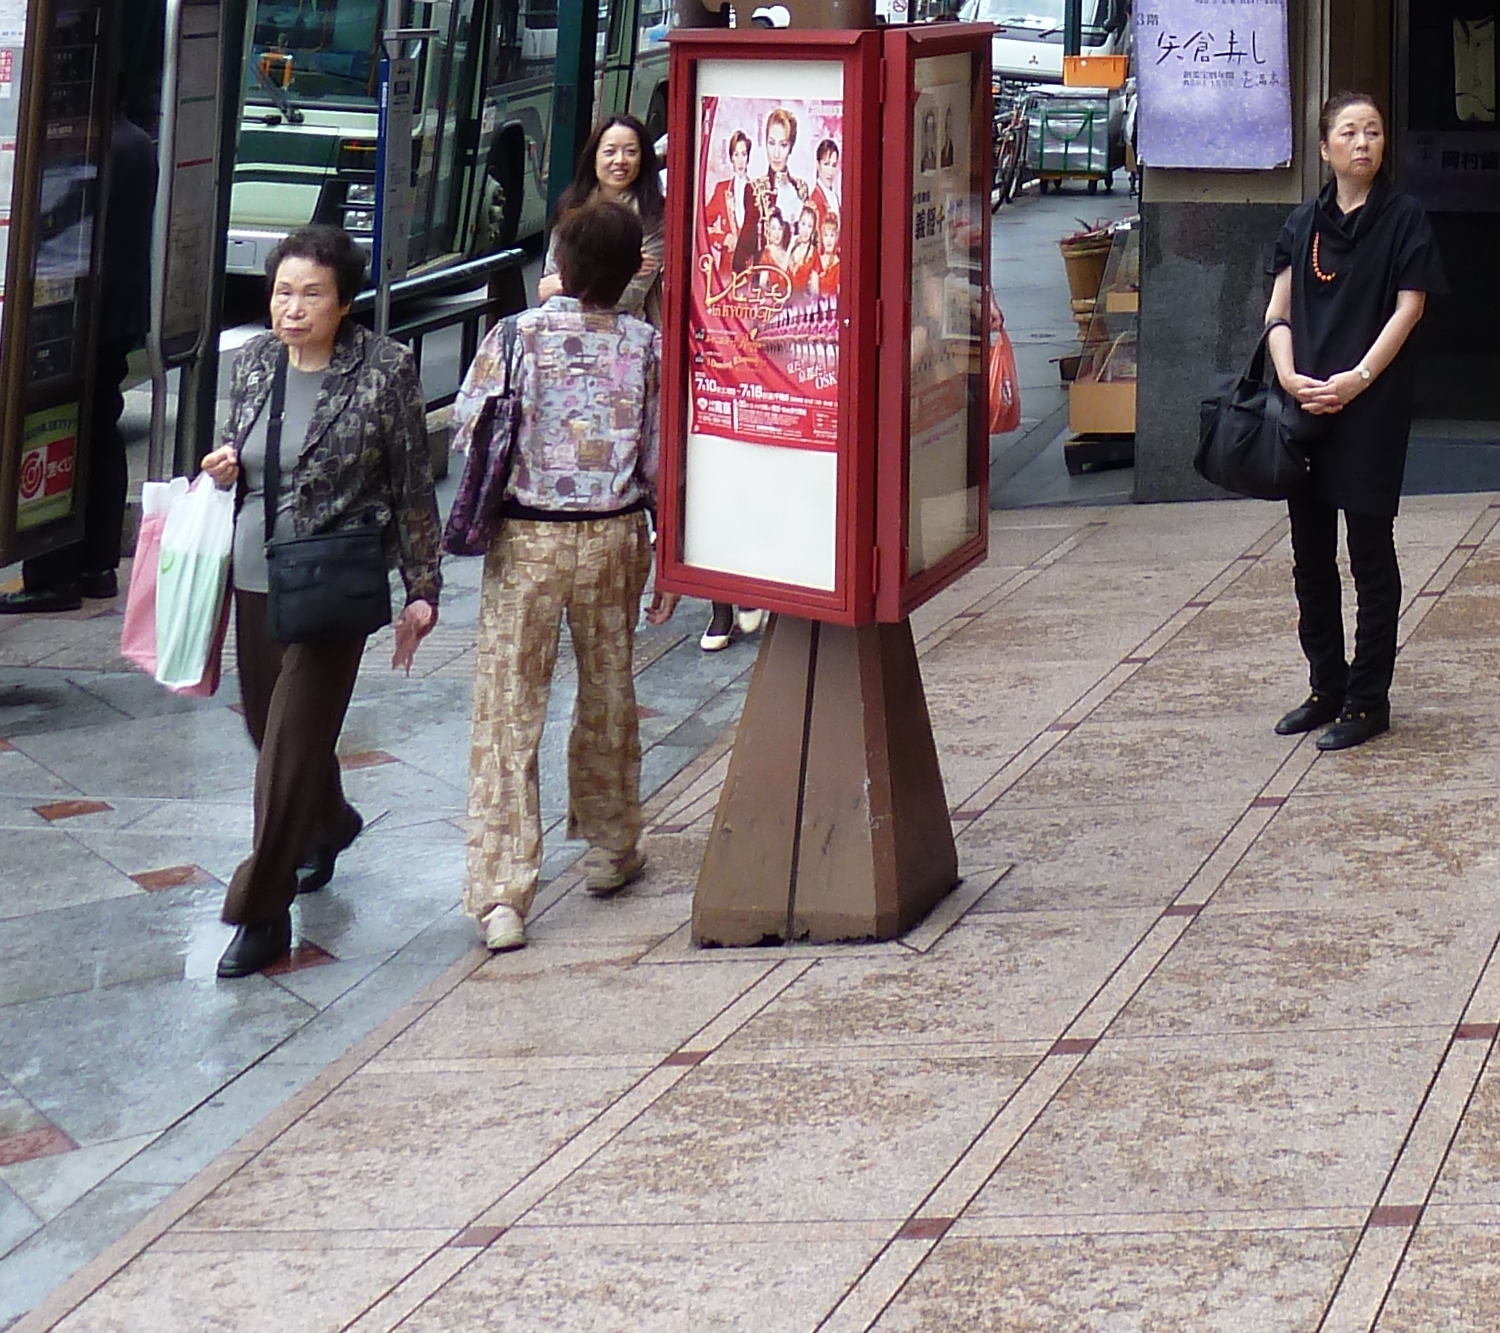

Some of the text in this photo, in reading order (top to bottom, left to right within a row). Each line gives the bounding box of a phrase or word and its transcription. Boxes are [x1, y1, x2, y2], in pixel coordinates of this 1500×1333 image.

[1156, 29, 1266, 65] 矢倉寿し
[723, 305, 757, 319] KYOTO
